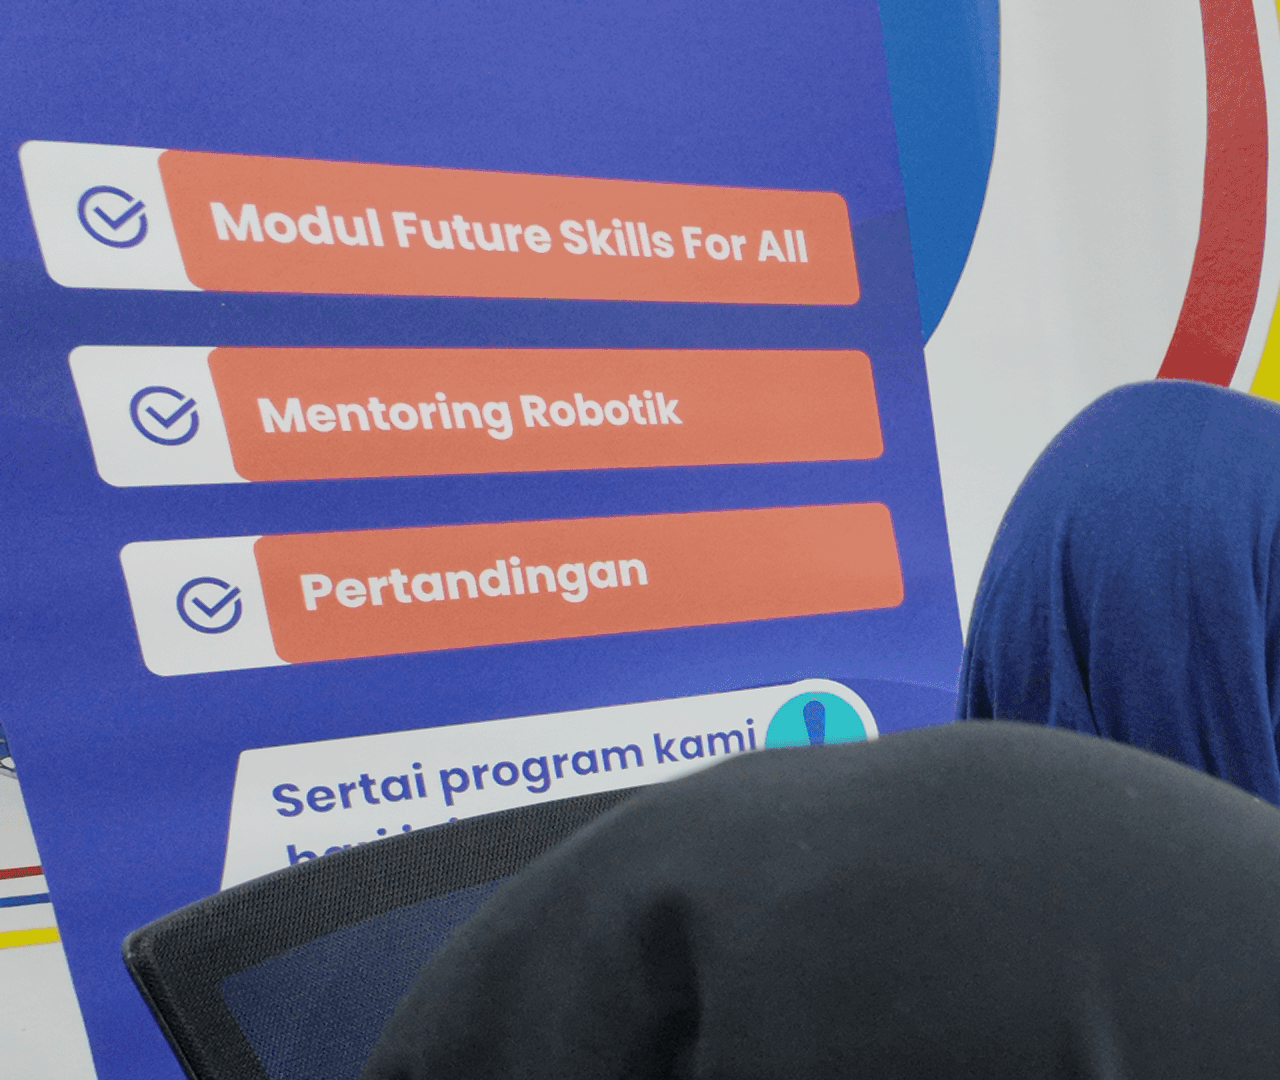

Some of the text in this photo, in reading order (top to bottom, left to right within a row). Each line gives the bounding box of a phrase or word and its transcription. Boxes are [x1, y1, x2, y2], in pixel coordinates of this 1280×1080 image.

[210, 202, 809, 263] Modul Future Skills For All
[257, 389, 684, 441] Mentoring Robotik
[300, 555, 649, 611] Pertandingan
[271, 717, 757, 817] Sertai program kami
